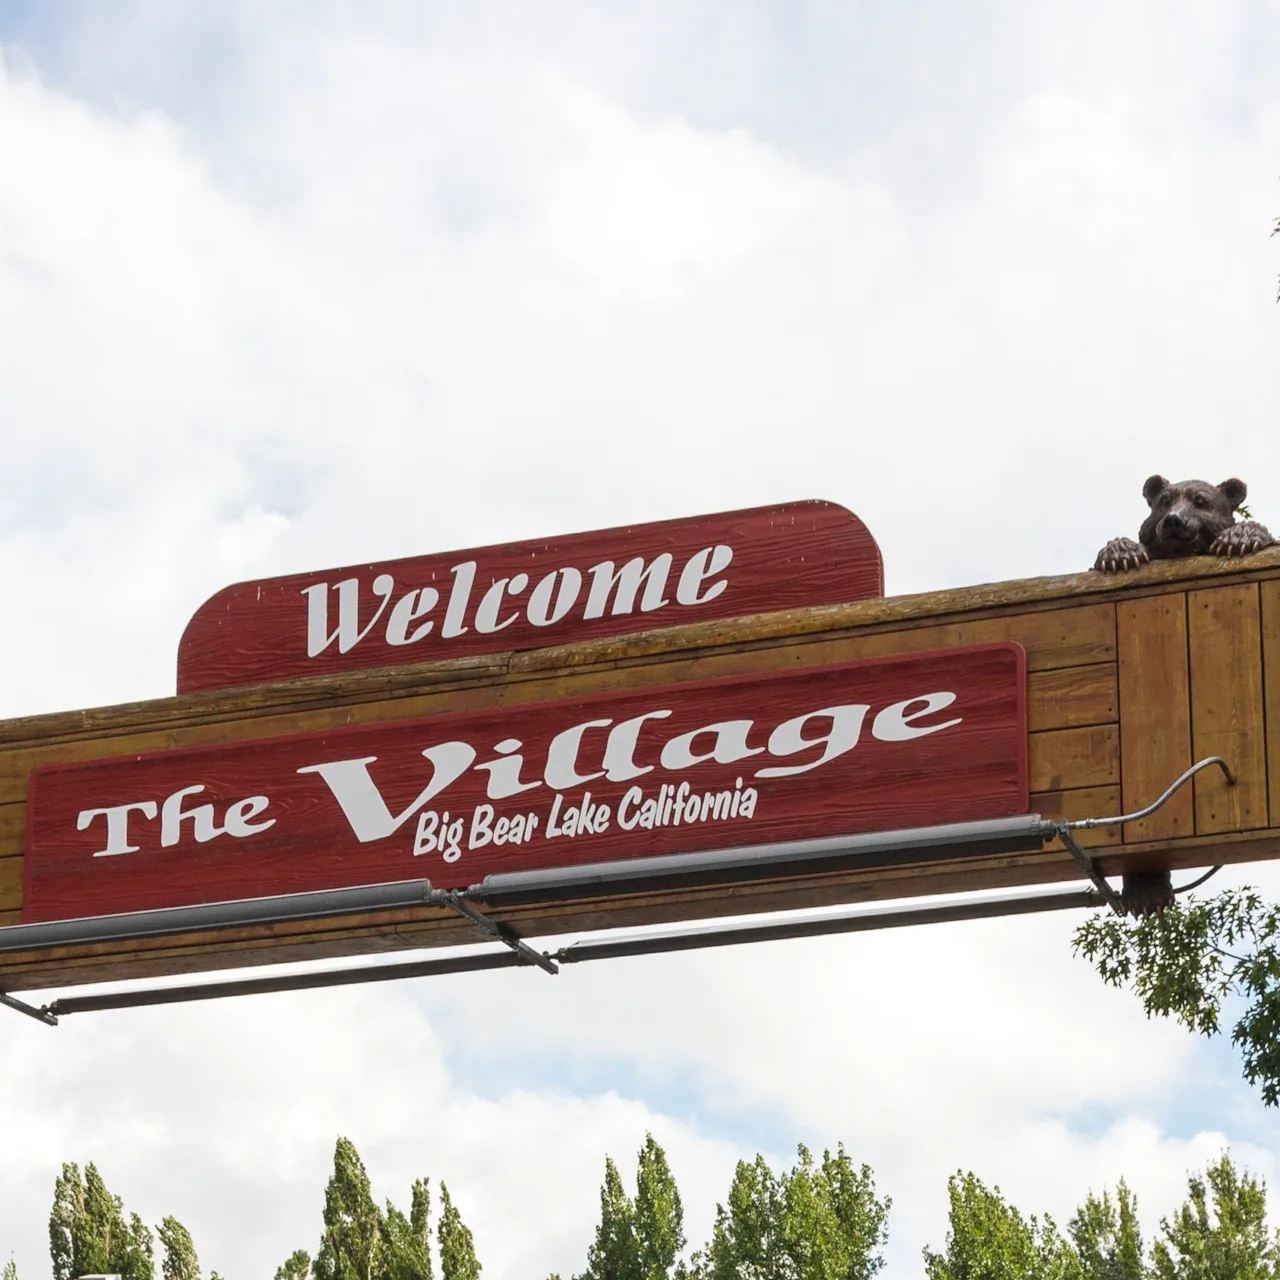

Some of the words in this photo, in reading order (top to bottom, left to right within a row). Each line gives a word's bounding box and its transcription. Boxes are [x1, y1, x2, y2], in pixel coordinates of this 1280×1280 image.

[300, 544, 734, 658] Welcome
[76, 784, 277, 858] The
[295, 691, 963, 843] Village
[412, 810, 464, 864] Big
[468, 803, 539, 851] Bear
[545, 791, 610, 840] Lake
[617, 777, 758, 832] California
